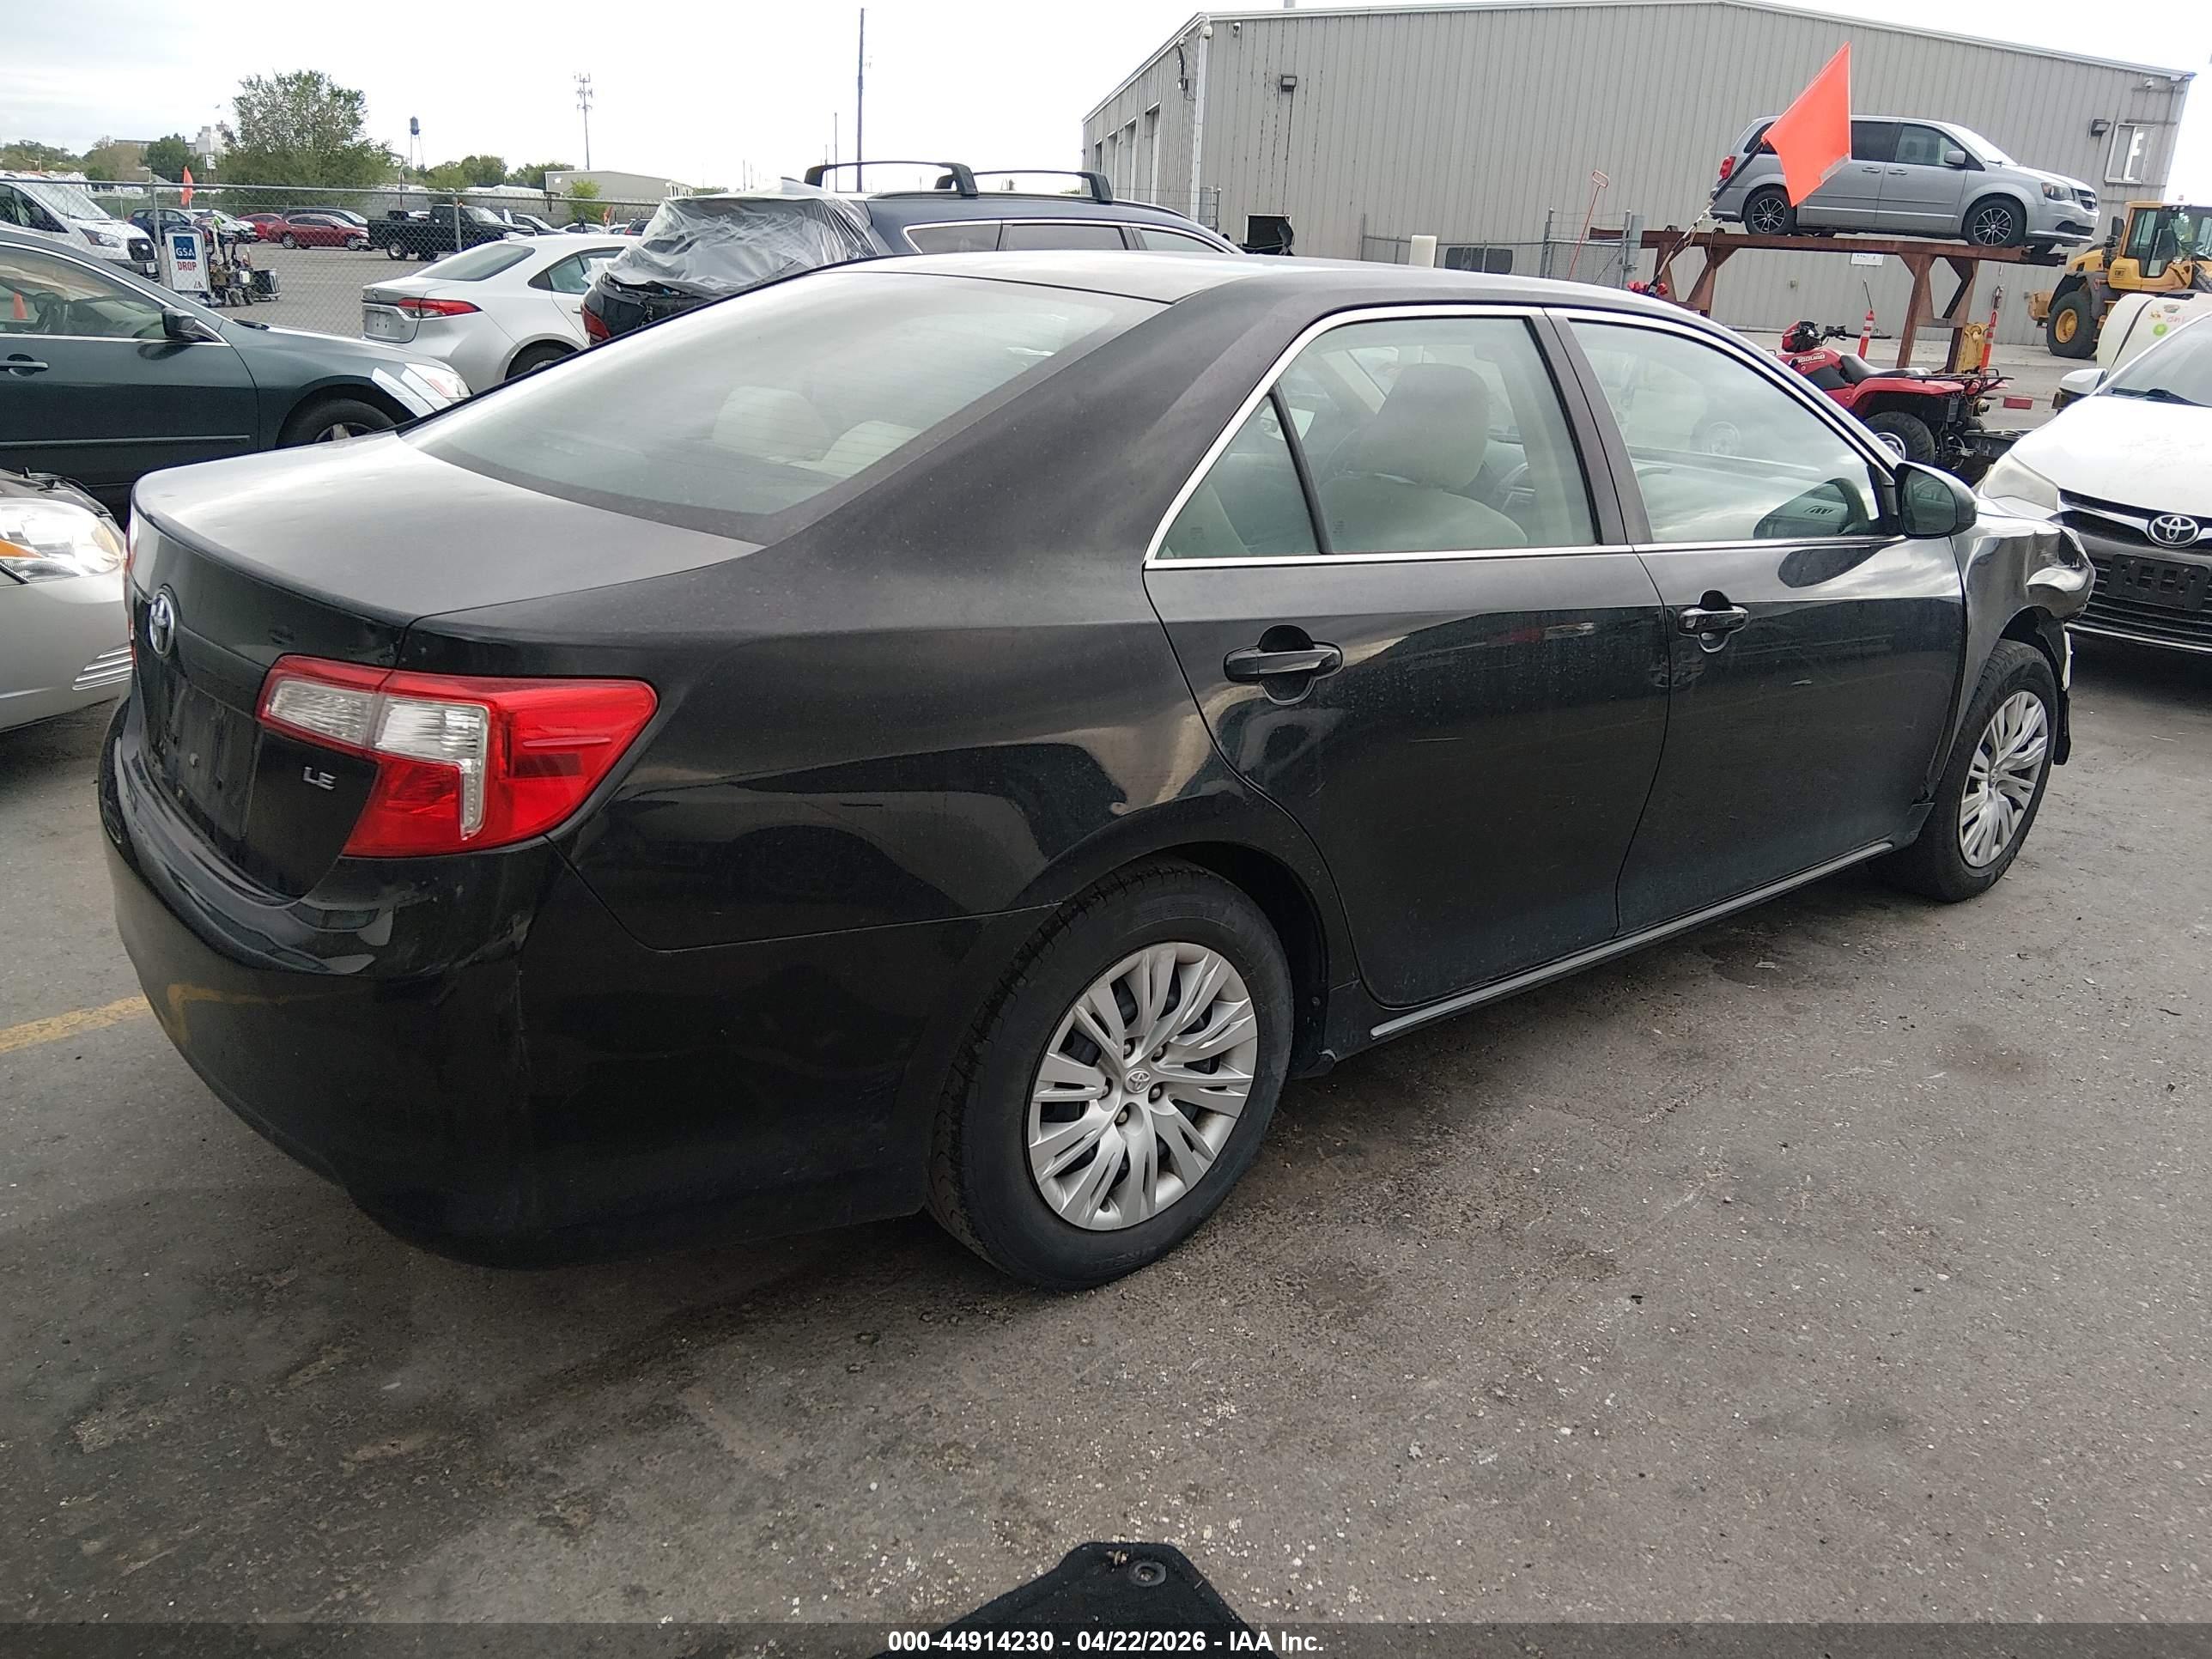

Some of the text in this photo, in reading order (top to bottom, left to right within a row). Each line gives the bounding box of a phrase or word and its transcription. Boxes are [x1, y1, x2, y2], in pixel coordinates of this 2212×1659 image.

[175, 247, 195, 257] GSA
[177, 261, 197, 271] DROP
[302, 766, 337, 791] LE
